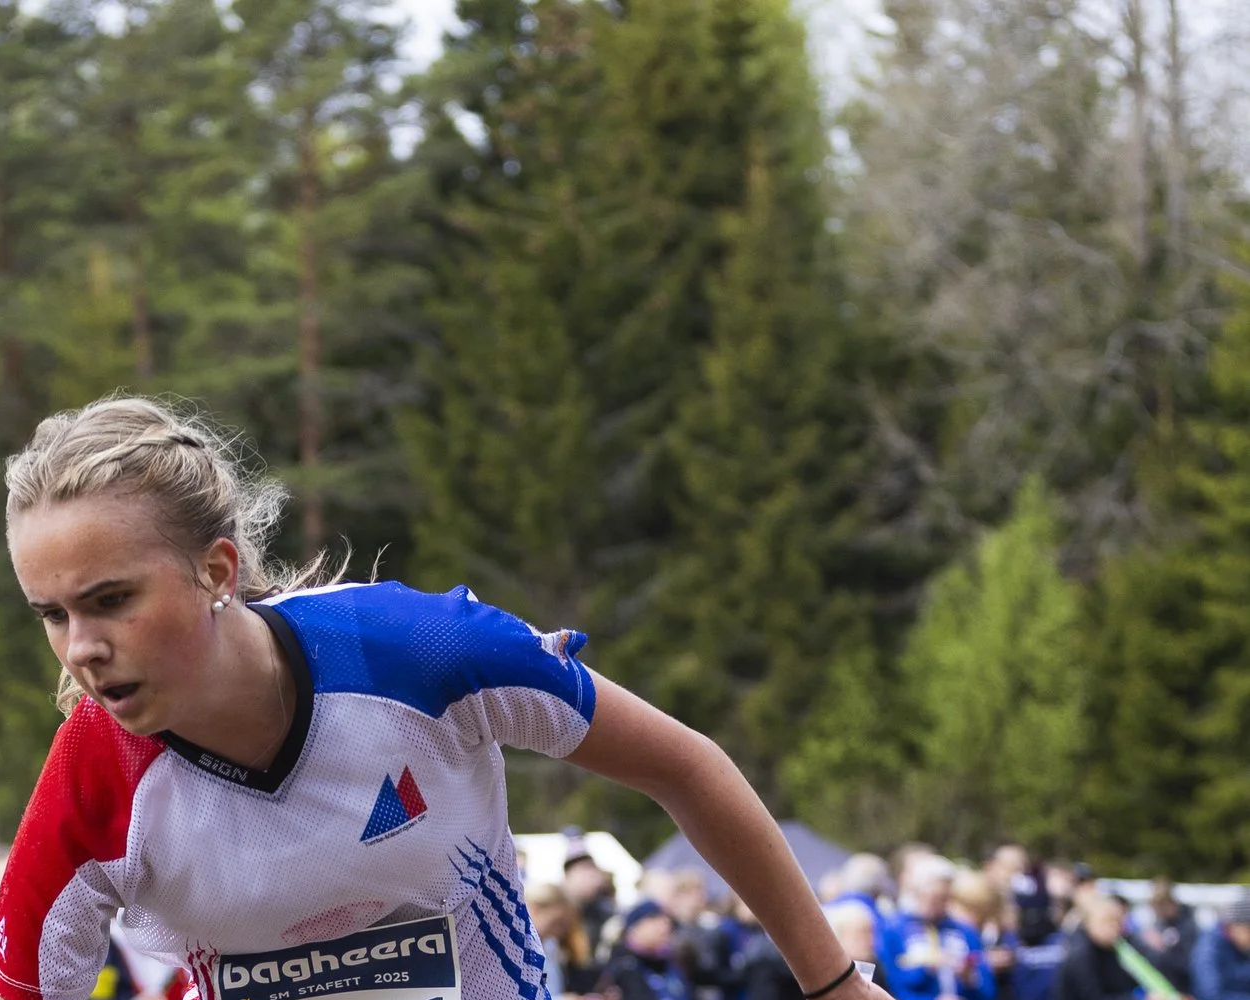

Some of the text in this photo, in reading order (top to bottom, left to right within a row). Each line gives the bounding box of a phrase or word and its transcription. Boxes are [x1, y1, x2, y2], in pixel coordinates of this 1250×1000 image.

[222, 933, 446, 990] bagheera
[269, 971, 410, 1000] SM STAFETT 2025
